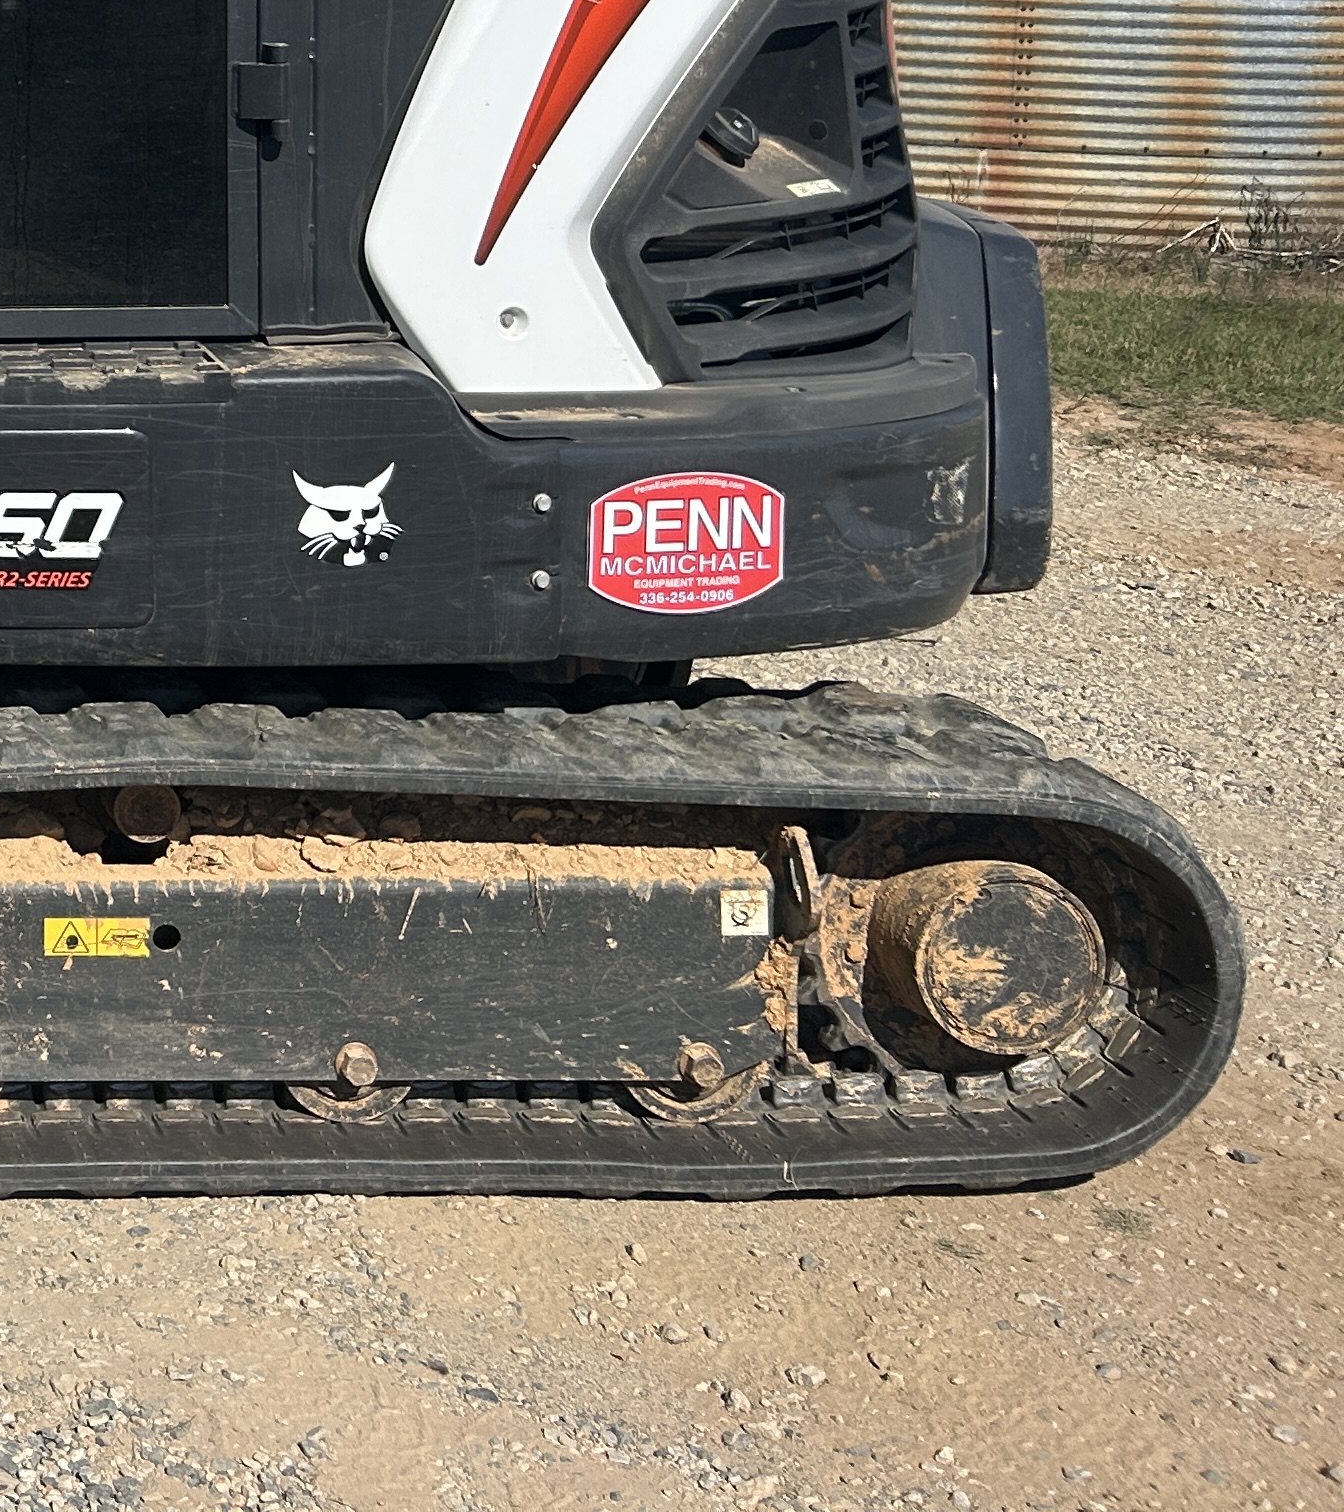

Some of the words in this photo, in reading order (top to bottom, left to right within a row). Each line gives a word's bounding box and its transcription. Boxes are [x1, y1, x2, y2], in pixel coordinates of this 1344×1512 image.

[602, 495, 773, 554] PENN
[600, 551, 772, 576] MCMICHAEL
[633, 576, 693, 589] EQUIPMENT
[696, 574, 740, 586] TRADING
[639, 589, 734, 605] 336-254-0906
